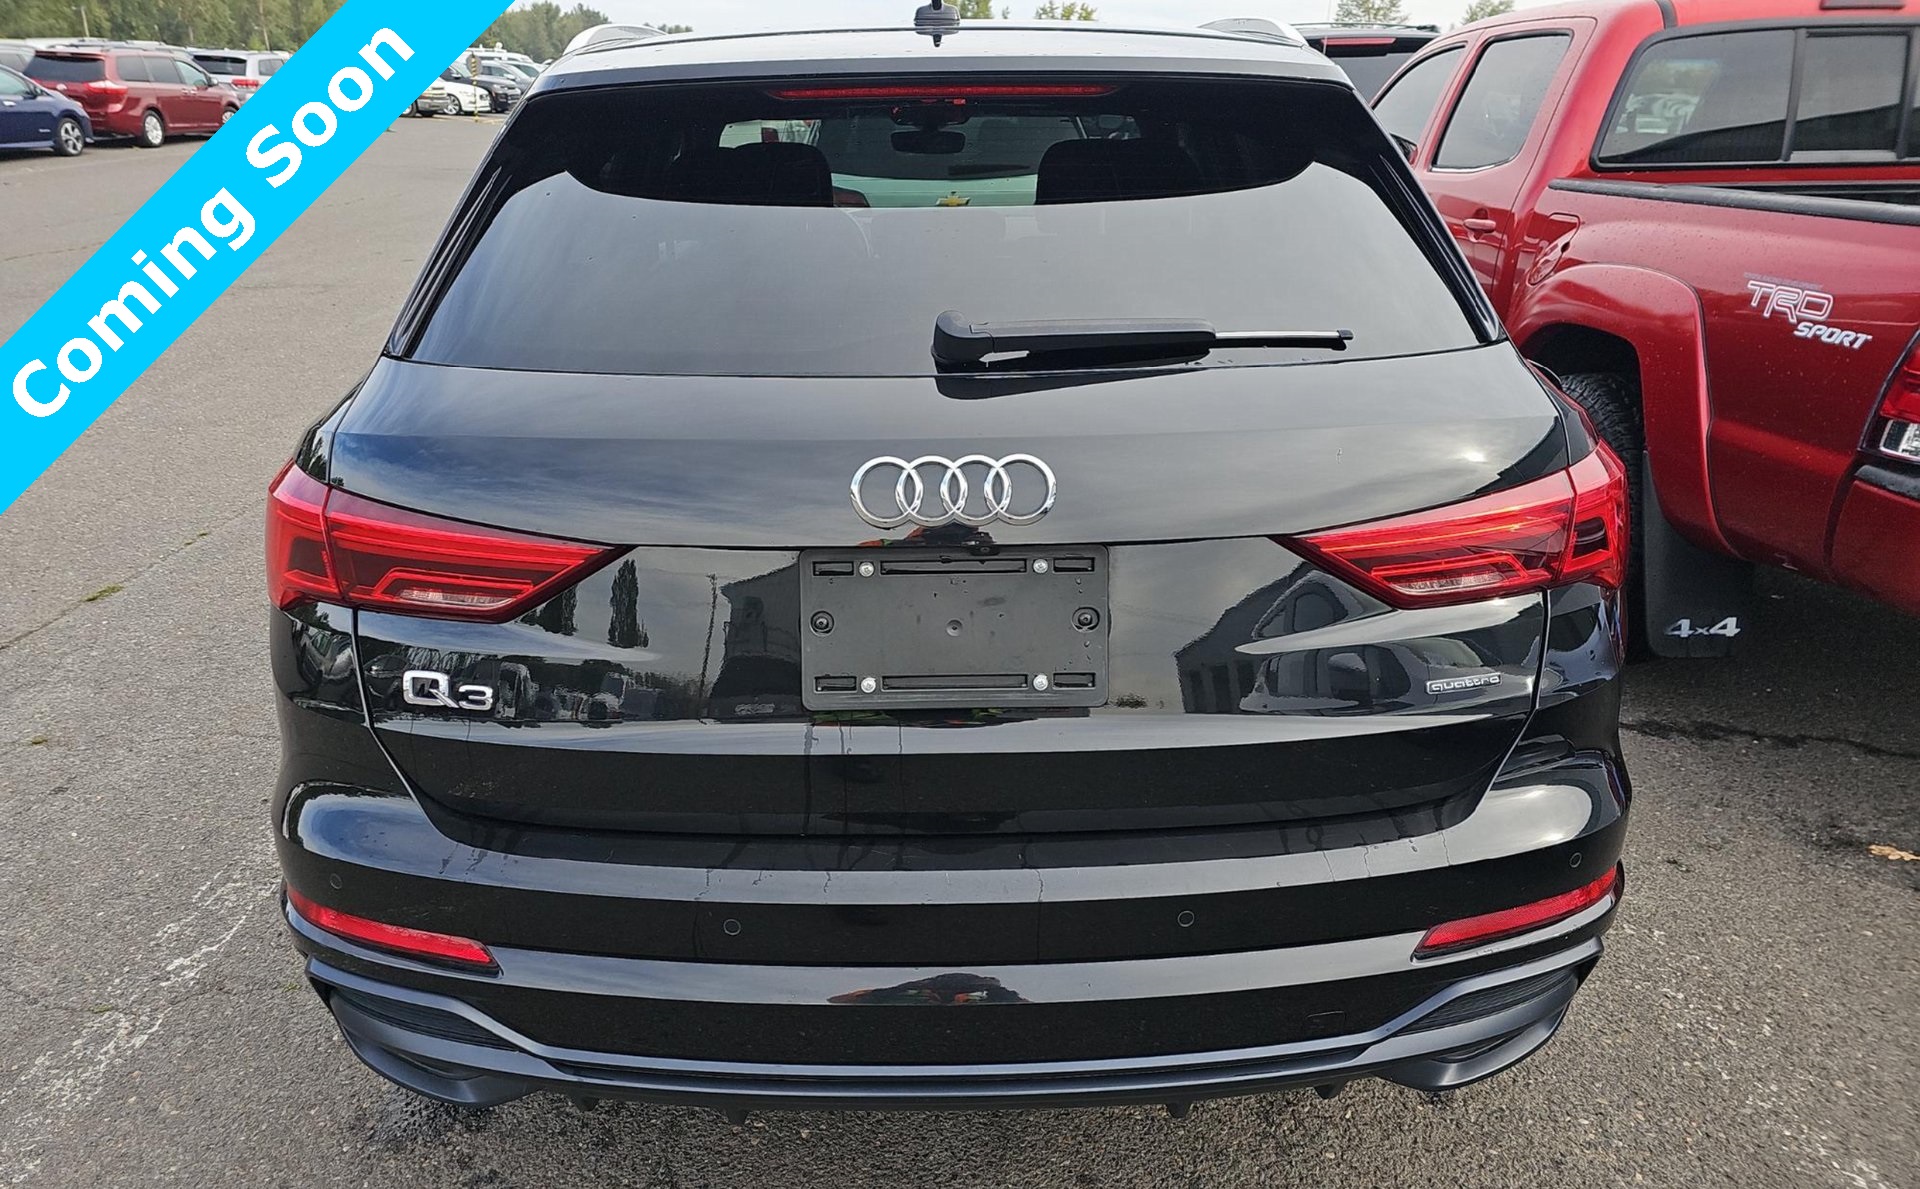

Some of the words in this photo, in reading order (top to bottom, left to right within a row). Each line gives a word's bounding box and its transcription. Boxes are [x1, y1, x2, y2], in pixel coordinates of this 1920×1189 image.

[1747, 280, 1833, 323] TRD
[1793, 321, 1873, 350] SPORT
[403, 670, 493, 711] Q3
[1431, 676, 1500, 691] quattro
